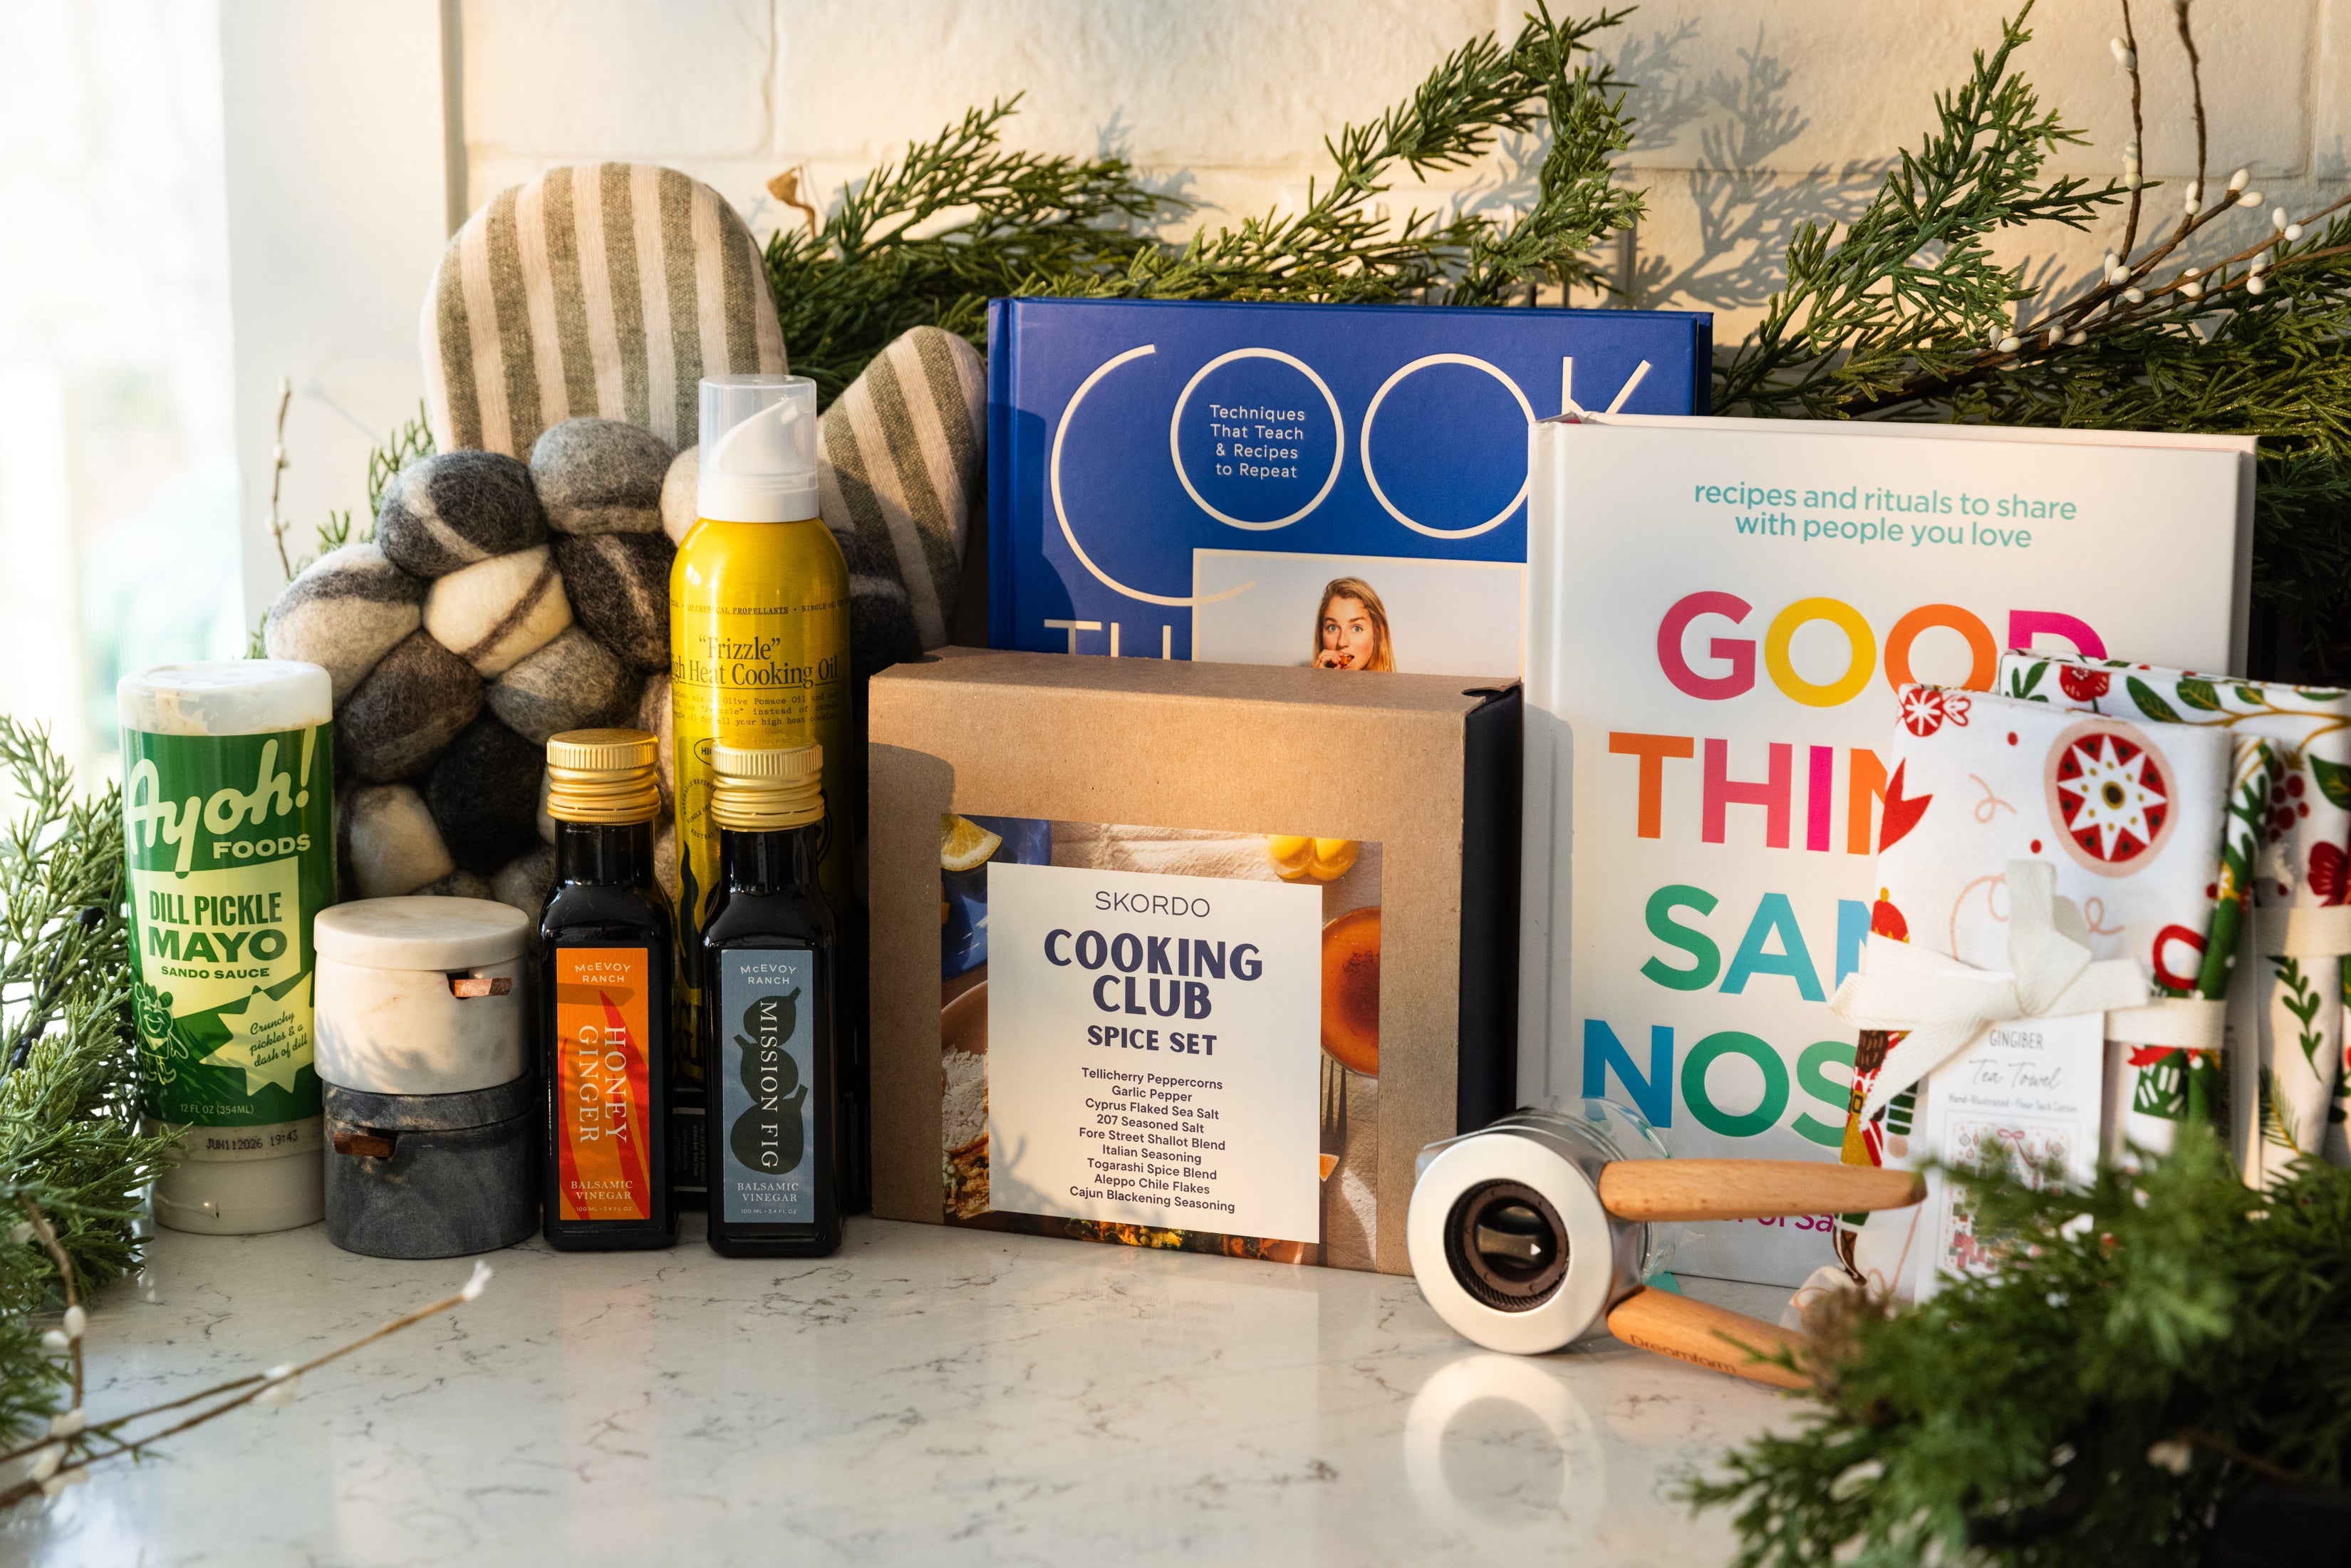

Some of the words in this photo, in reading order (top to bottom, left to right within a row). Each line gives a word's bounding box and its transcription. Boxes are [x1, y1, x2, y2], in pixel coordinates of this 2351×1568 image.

[1210, 404, 1305, 423] Techniques
[1210, 423, 1248, 438] That
[1255, 425, 1304, 440] Teach
[1215, 442, 1225, 456] &
[1234, 444, 1298, 461] Recipes
[1215, 463, 1232, 475] to
[1240, 463, 1297, 479] Repeat
[1694, 482, 1797, 509] recipes
[1803, 487, 1857, 509] and
[1865, 488, 1953, 514] rituals
[1960, 493, 1990, 516] to
[1996, 494, 2077, 520] share
[1734, 512, 1795, 536] with
[1803, 517, 1904, 544] people
[1911, 524, 1963, 547] you
[1972, 521, 2032, 548] love
[695, 605, 730, 613] CHEMCAL
[732, 606, 789, 615] PROPELLANTS
[802, 603, 826, 613] SINGLE
[689, 660, 726, 684] Heat
[732, 661, 814, 690] Cooking
[818, 655, 839, 681] Oil
[752, 707, 792, 715] instead
[762, 718, 782, 727] high
[125, 726, 316, 879] Ayoh!
[213, 834, 311, 859] FOODS
[149, 890, 190, 925] DILL
[195, 892, 282, 926] PICKLE
[1095, 891, 1210, 918] SKORDO
[148, 927, 288, 963] MAYO
[1044, 928, 1262, 981] COOKING
[161, 966, 209, 979] SANDO
[214, 967, 270, 980] SAUCE
[574, 962, 632, 973] McEVOY
[740, 963, 797, 975] McEVOY
[582, 975, 625, 983] RANCH
[747, 977, 790, 985] RANCH
[1093, 974, 1212, 1020] CLUB
[250, 1010, 295, 1035] Crunchy
[249, 1031, 286, 1056] pickles
[289, 1026, 296, 1037] &
[254, 1048, 279, 1066] dash
[281, 1042, 291, 1059] of
[292, 1032, 308, 1051] dill
[1086, 1024, 1160, 1051] SPICE
[1169, 1032, 1218, 1056] SET
[1989, 1029, 2044, 1050] GINGIBER
[760, 1001, 778, 1112] MISSION
[578, 1024, 600, 1143] GINGER
[604, 1026, 628, 1143] HONEY
[1081, 1067, 1143, 1084] Tellicherry
[1147, 1073, 1223, 1090] Peppercorns
[1969, 1059, 2003, 1084] Tea
[2008, 1061, 2062, 1089] Towel
[1111, 1085, 1146, 1098] Garlic
[1150, 1089, 1193, 1103] Pepper
[180, 1104, 188, 1113] 12
[190, 1105, 200, 1113] FL
[202, 1106, 214, 1114] OZ
[217, 1105, 254, 1115] (354ML)
[1085, 1098, 1126, 1111] Cyprus
[1130, 1102, 1168, 1115] Flaked
[1172, 1106, 1193, 1117] Sea
[1197, 1108, 1219, 1120] Salt
[1096, 1114, 1119, 1125] 207
[1121, 1116, 1178, 1131] Seasoned
[1182, 1122, 1204, 1133] Salt
[761, 1123, 779, 1168] FIG
[1079, 1128, 1105, 1139] Fore
[1109, 1130, 1144, 1143] Street
[1148, 1134, 1188, 1147] Shallot
[1192, 1138, 1225, 1151] Blend
[1103, 1144, 1138, 1157] Italian
[1141, 1148, 1202, 1165] Seasoning
[1087, 1158, 1143, 1173] Togarashi
[1147, 1164, 1180, 1177] Spice
[1183, 1168, 1217, 1180] Blend
[571, 1180, 633, 1190] BALSAMIC
[737, 1183, 799, 1191] BALSAMIC
[1094, 1174, 1136, 1188] Aleppo
[1138, 1178, 1169, 1190] Chile
[1173, 1181, 1210, 1194] Flakes
[576, 1191, 631, 1200] VINEGAR
[742, 1193, 797, 1202] VINEGAR
[1070, 1186, 1104, 1200] Cajun
[1107, 1190, 1171, 1208] Blackening
[1174, 1197, 1235, 1214] Seasoning
